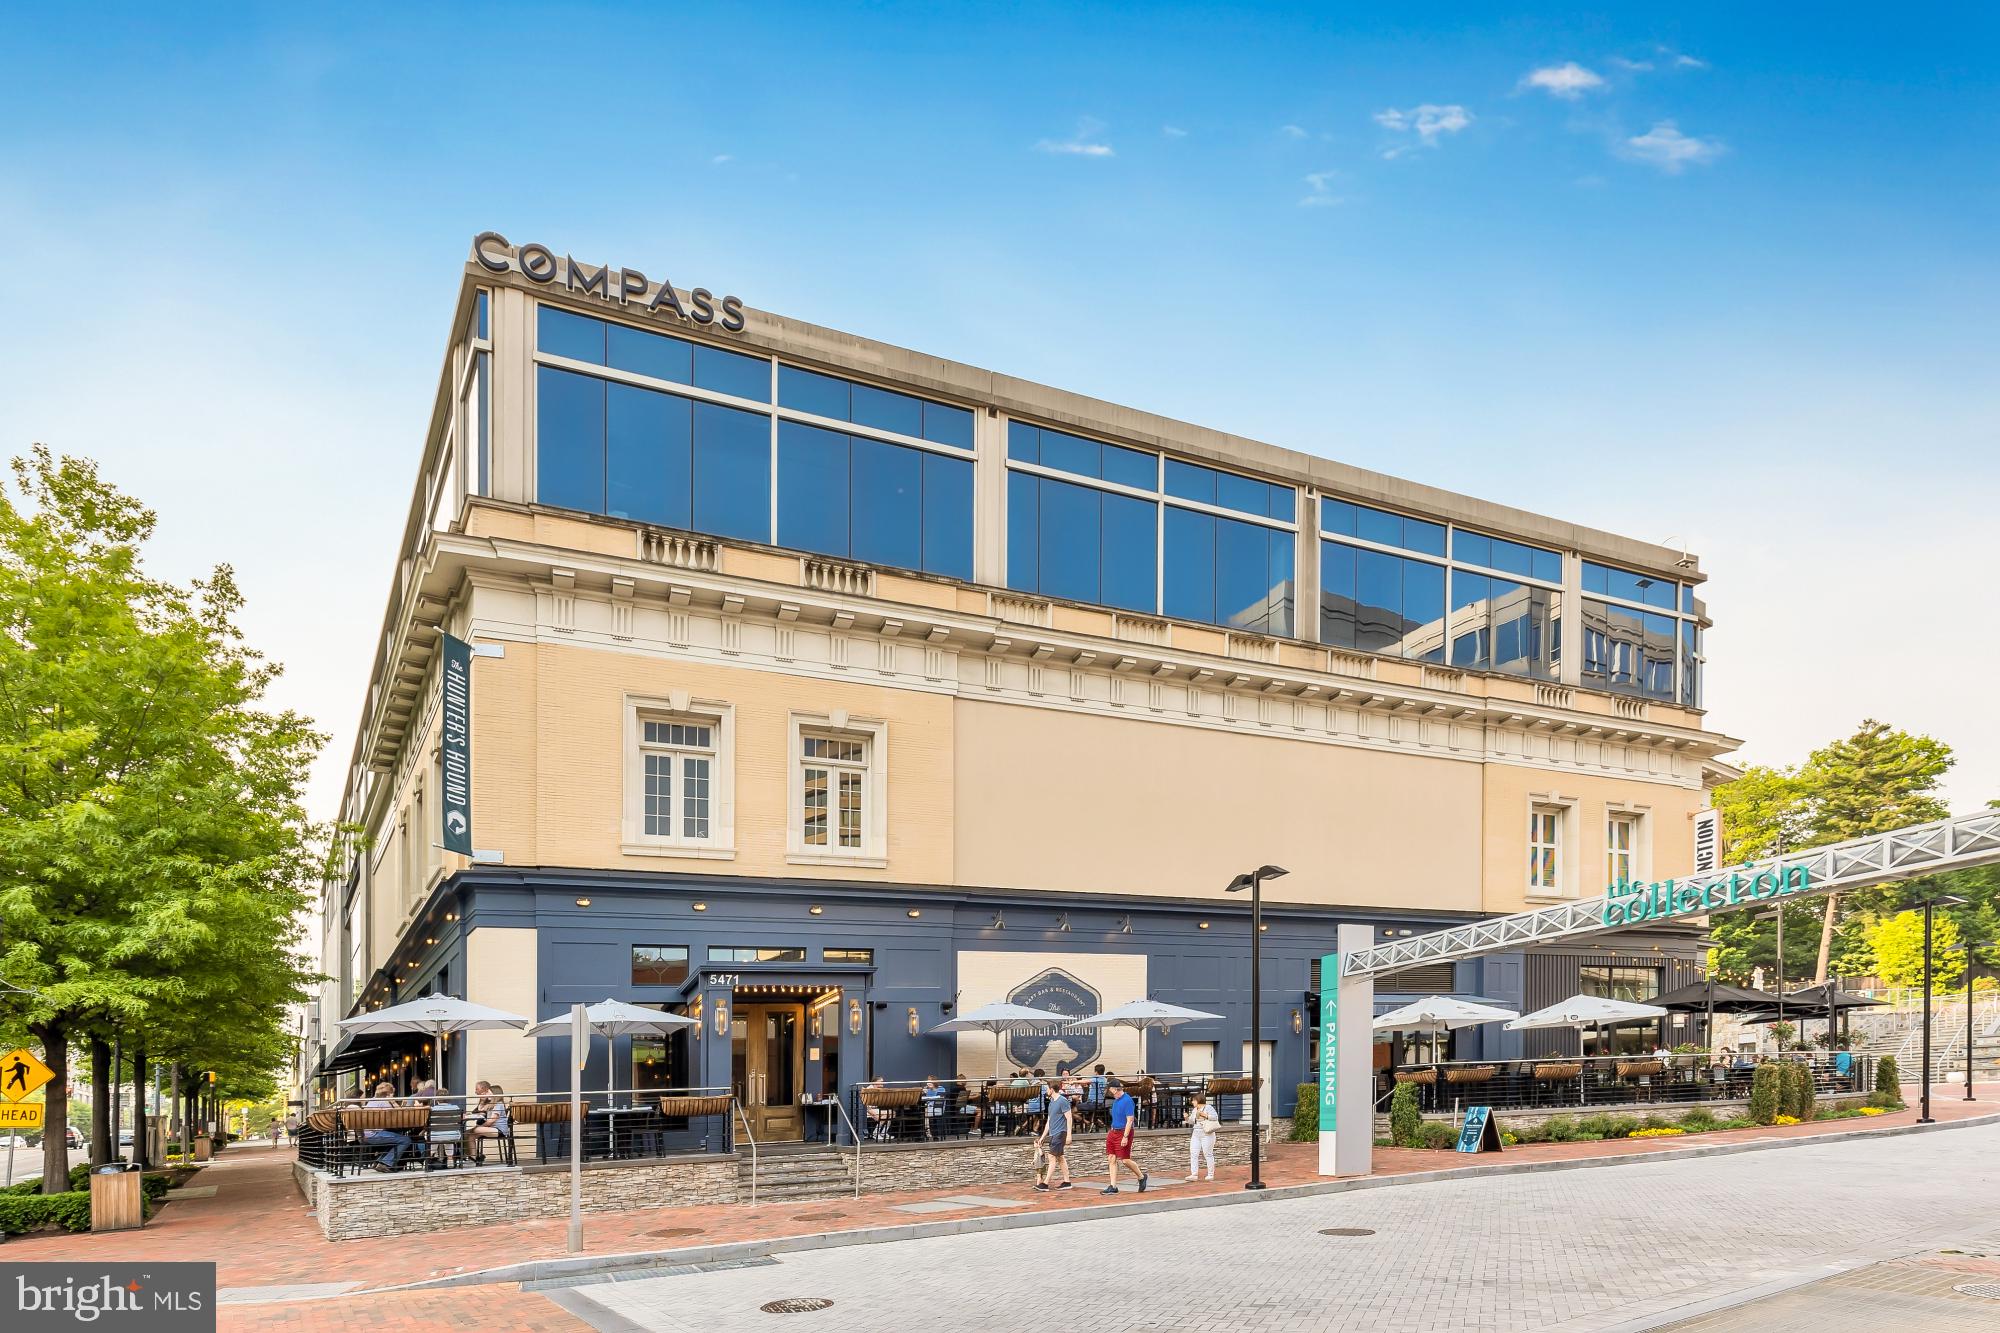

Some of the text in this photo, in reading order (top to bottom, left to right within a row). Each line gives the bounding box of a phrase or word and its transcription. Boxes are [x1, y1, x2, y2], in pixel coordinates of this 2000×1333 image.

[474, 231, 746, 333] COMPASS
[451, 659, 464, 672] The
[447, 670, 466, 806] HUNTER'S HOUND
[1696, 819, 1714, 874] NCTION
[1607, 876, 1644, 899] the
[709, 974, 739, 985] 5471
[1325, 1022, 1336, 1105] PARKING
